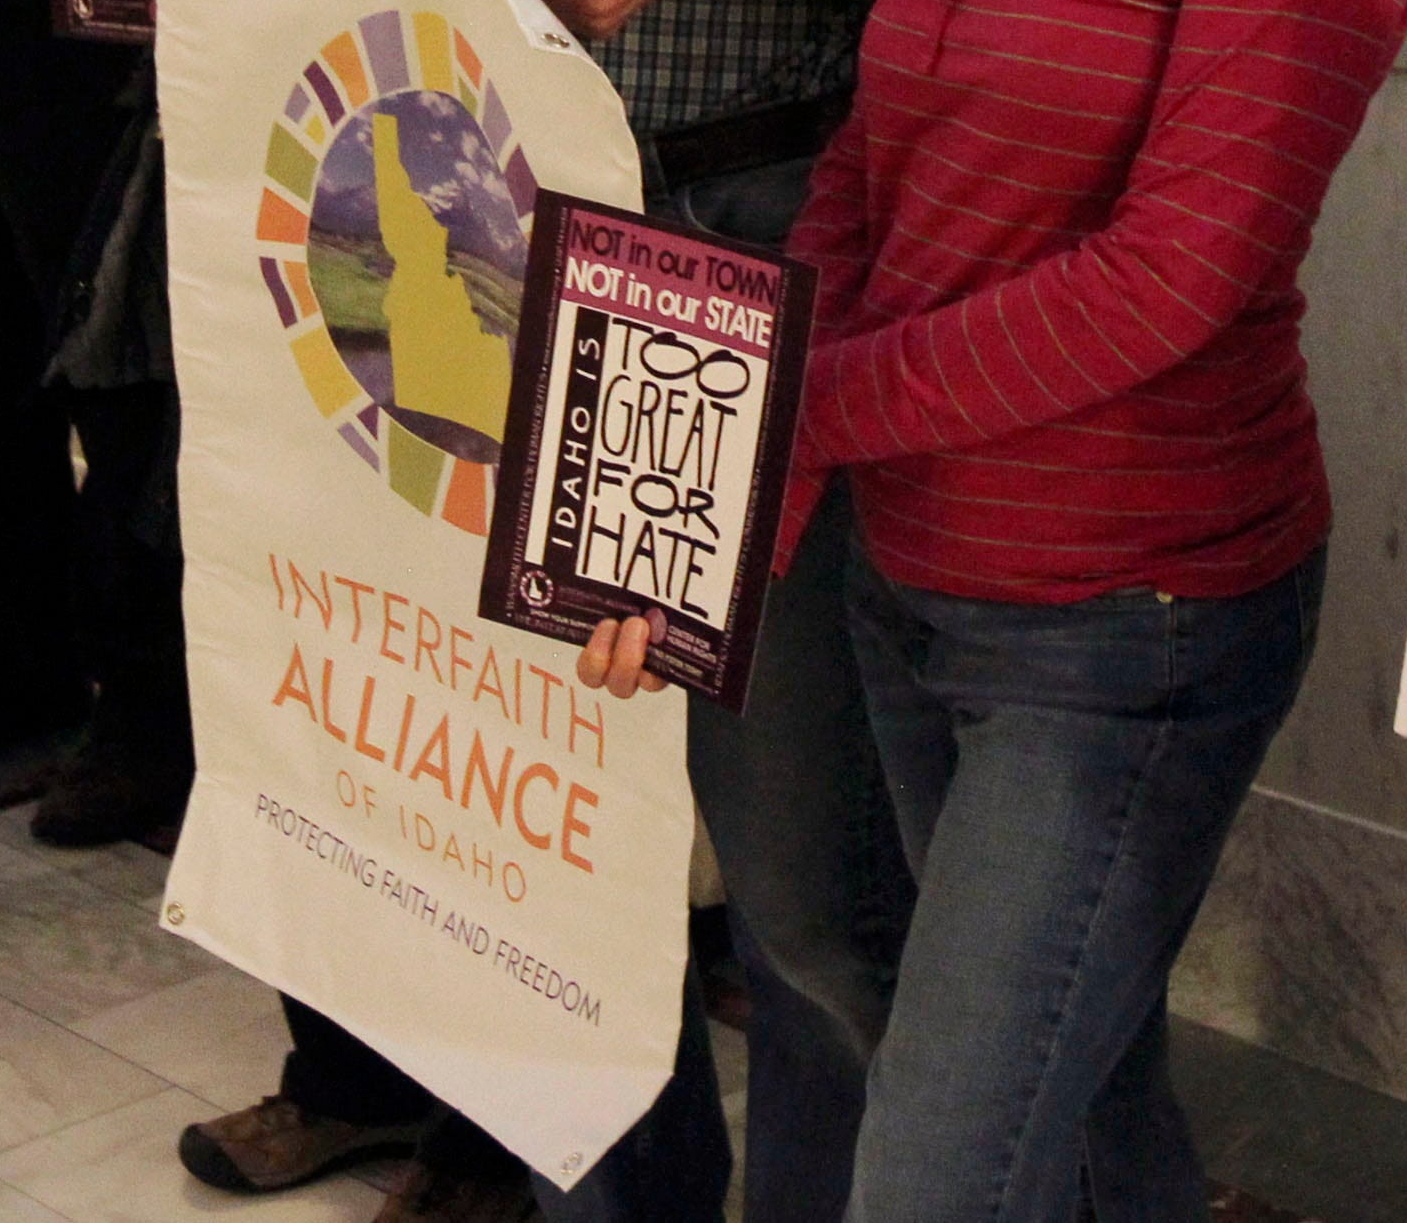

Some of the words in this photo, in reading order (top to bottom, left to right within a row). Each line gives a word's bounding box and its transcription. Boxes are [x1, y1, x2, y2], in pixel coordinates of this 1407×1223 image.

[564, 257, 624, 302] NOT
[625, 273, 651, 311] in
[656, 289, 702, 323] our
[704, 295, 774, 348] STATE
[569, 220, 625, 256] NOT
[630, 235, 651, 269] in
[656, 249, 698, 281] our
[704, 255, 777, 307] TOWN
[613, 318, 750, 399] TOO
[551, 406, 593, 549] IDAHO
[577, 338, 602, 381] IS
[601, 375, 738, 492] GREAT
[594, 458, 720, 540] FOR
[581, 505, 717, 620] HATE
[267, 554, 606, 768] INTERFAITH
[272, 642, 600, 874] ALLIANCE
[336, 769, 377, 819] OF
[399, 806, 527, 903] IDAHO
[255, 793, 377, 888] PROTECTING
[380, 870, 438, 926] FAITH
[442, 909, 490, 957] AND
[494, 940, 603, 1028] FREEDOM
